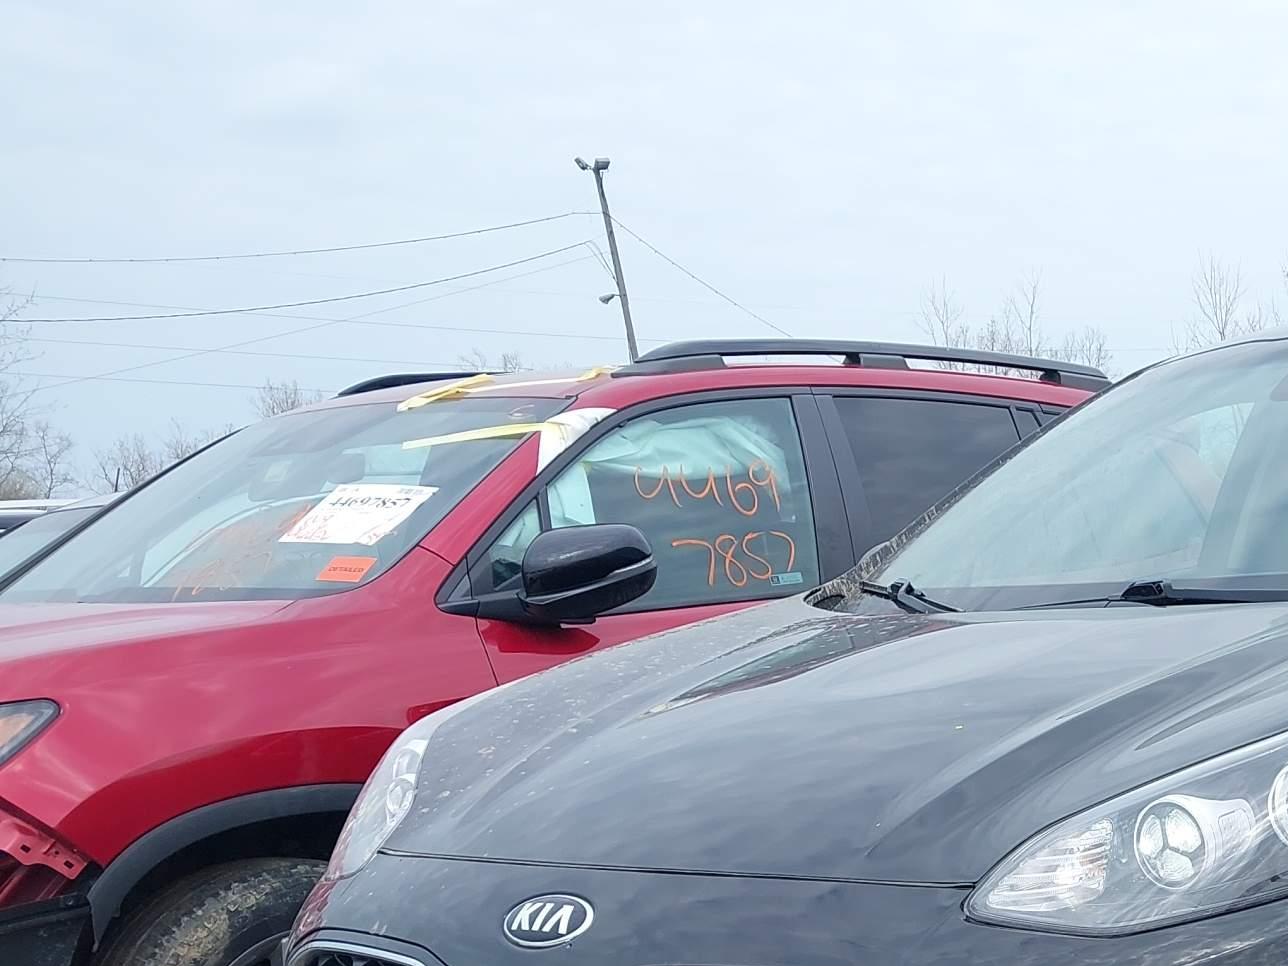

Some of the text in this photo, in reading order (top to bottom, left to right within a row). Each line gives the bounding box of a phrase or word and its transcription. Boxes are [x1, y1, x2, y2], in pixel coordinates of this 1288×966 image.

[634, 459, 781, 517] 4469
[671, 530, 796, 587] 7857
[511, 902, 575, 935] KIA
